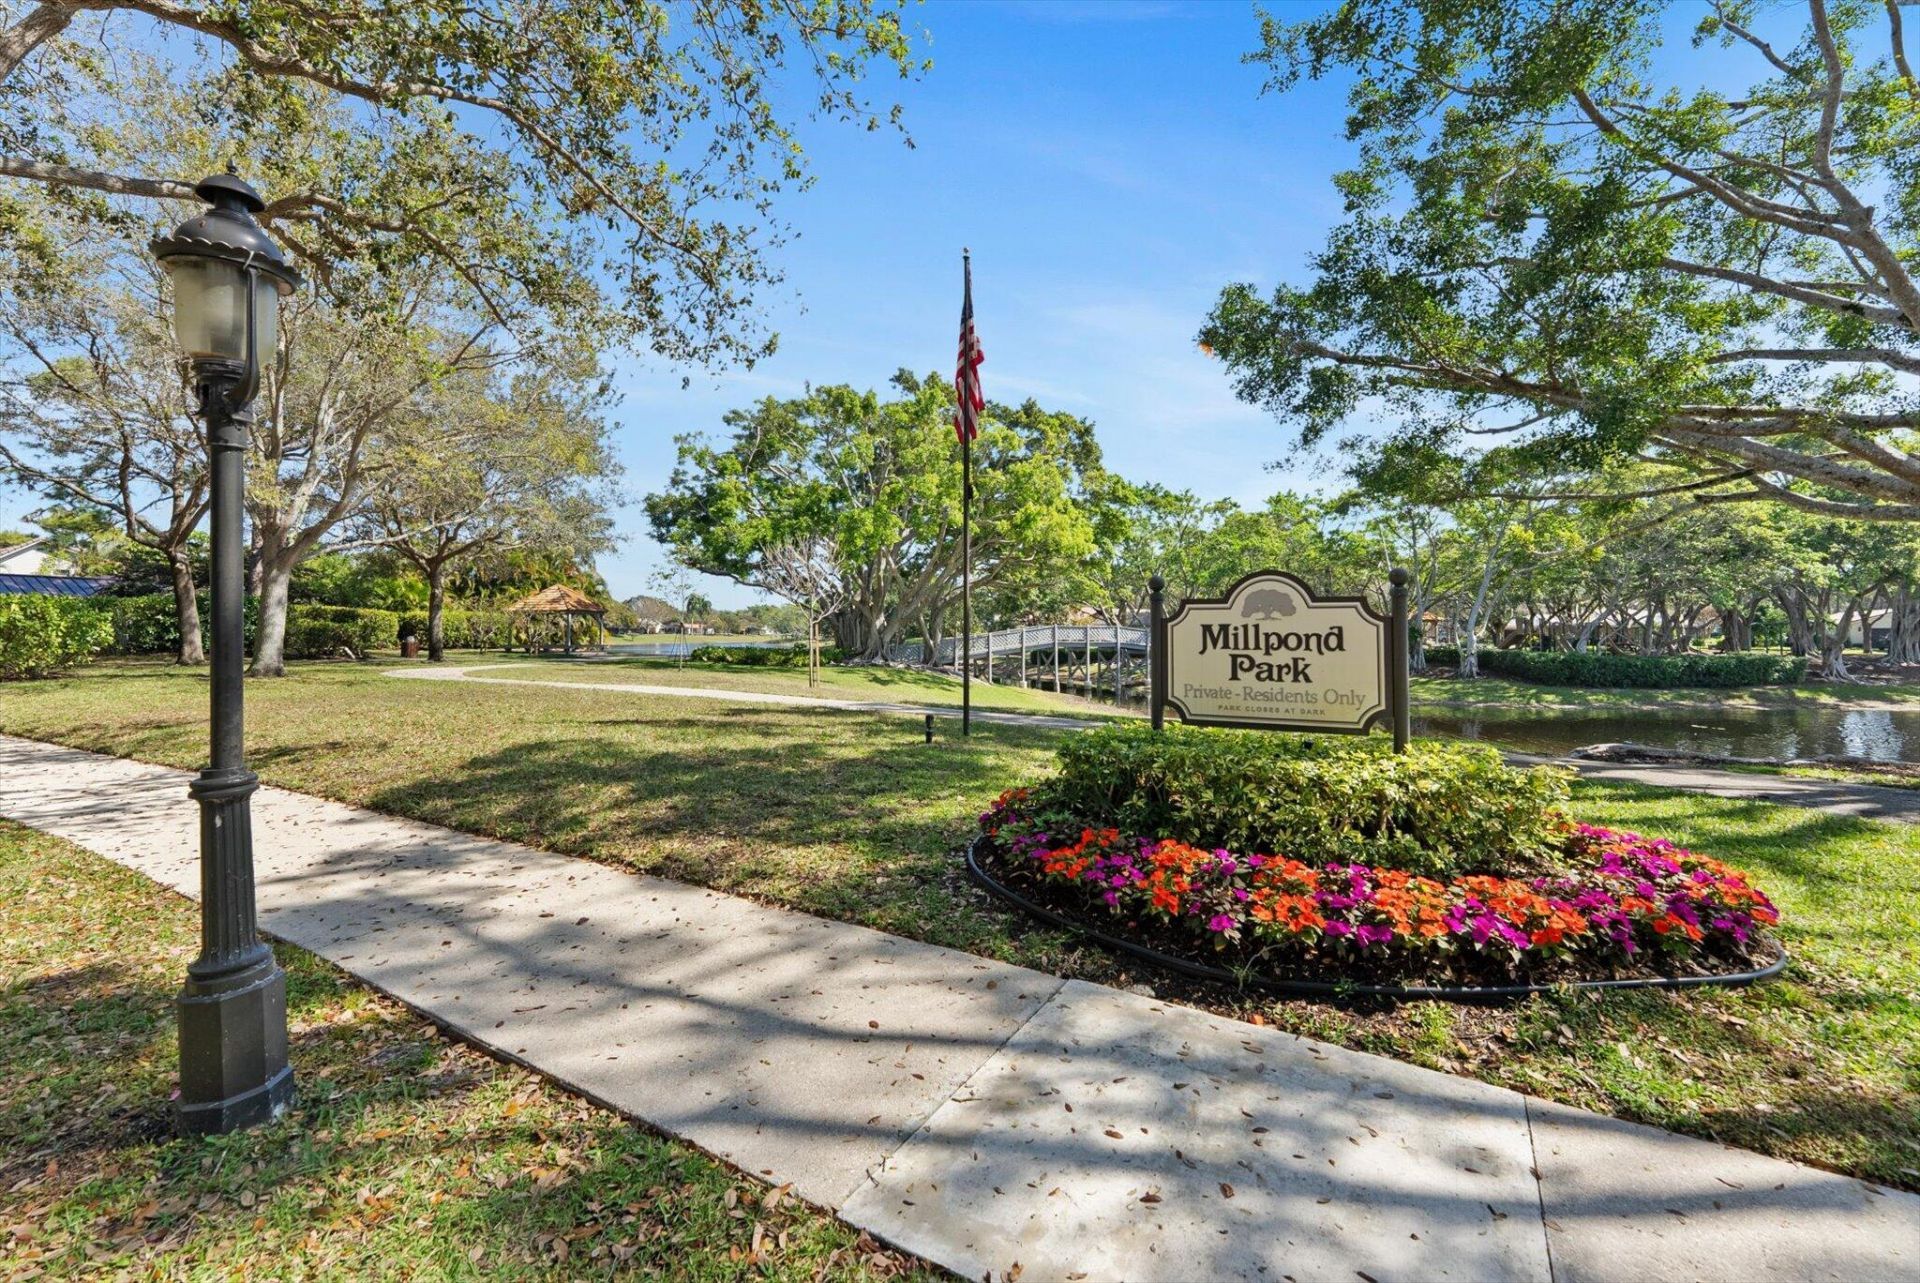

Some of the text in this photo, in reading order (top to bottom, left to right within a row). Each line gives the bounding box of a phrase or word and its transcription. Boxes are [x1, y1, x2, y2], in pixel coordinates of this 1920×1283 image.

[1198, 623, 1346, 656] Millpond
[1228, 653, 1313, 684] Park
[1183, 683, 1232, 699] Private
[1242, 685, 1318, 704] Residents
[1323, 688, 1366, 711] Only
[1217, 704, 1326, 716] PARK CLOSES AT DARK
